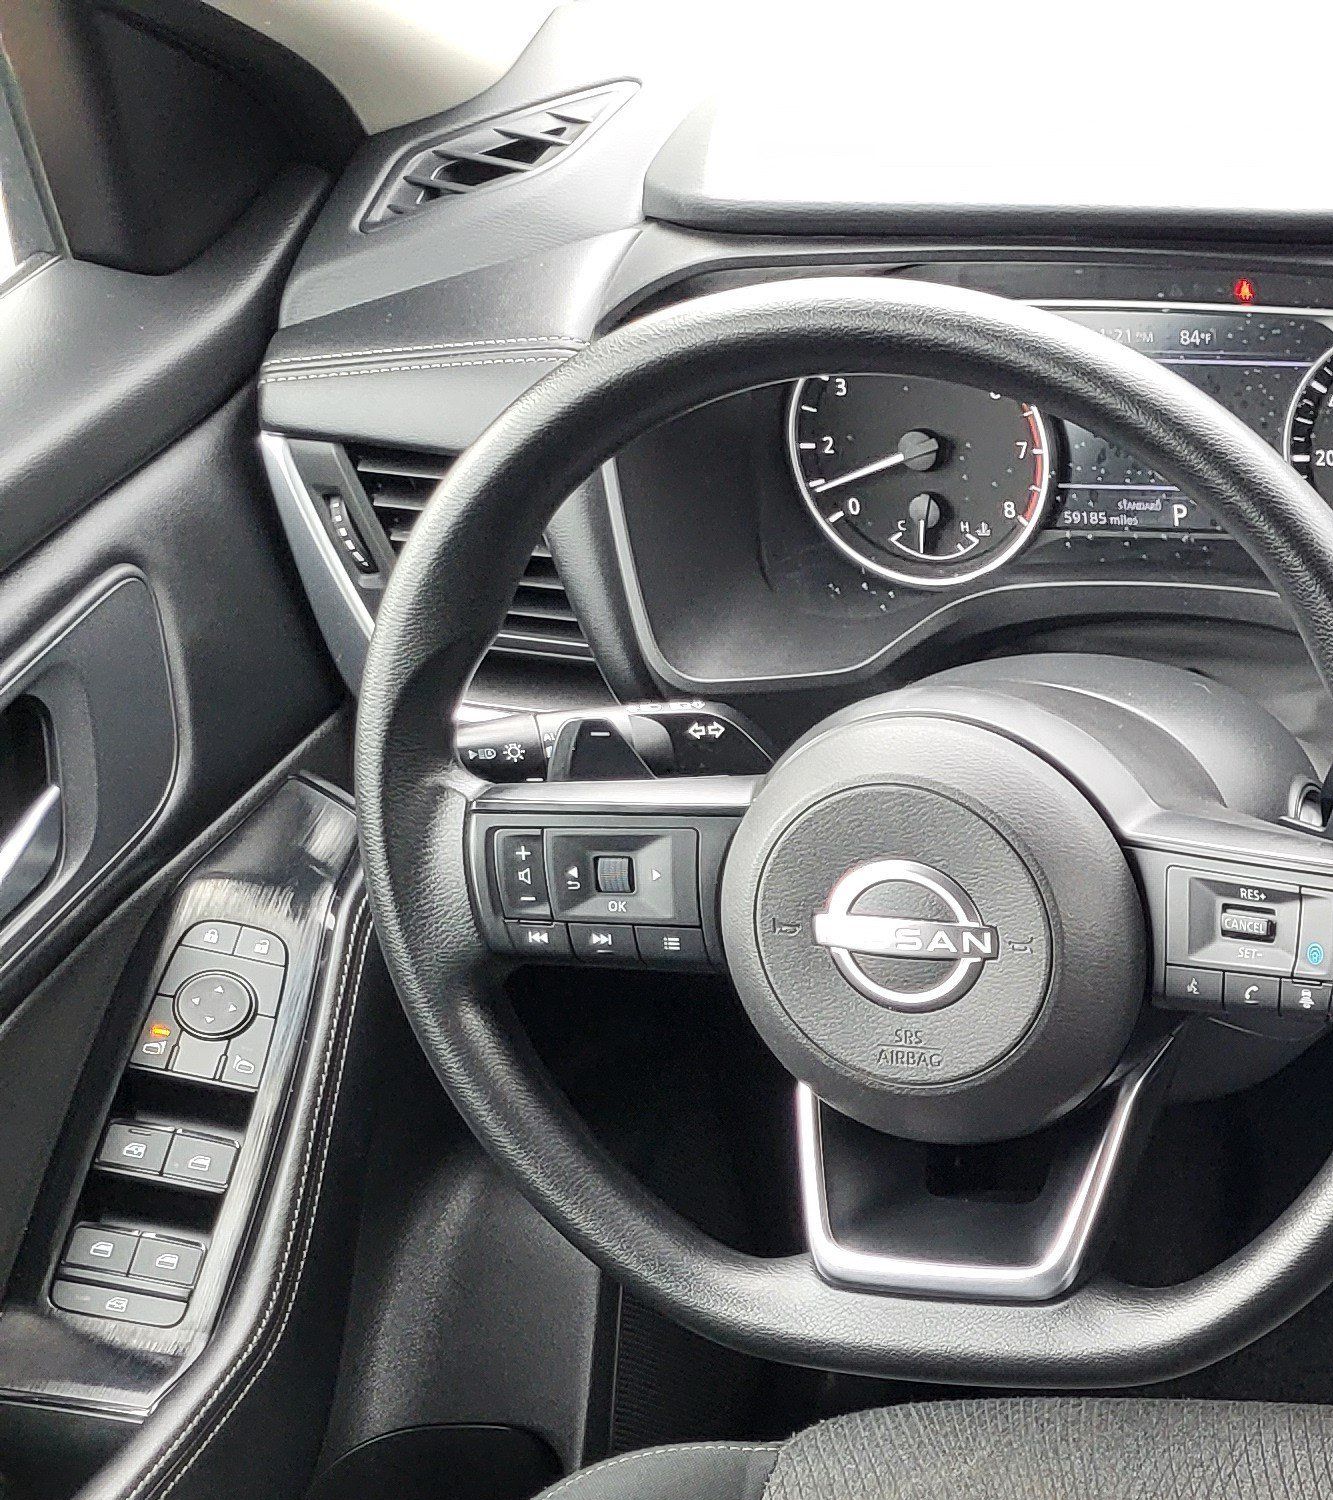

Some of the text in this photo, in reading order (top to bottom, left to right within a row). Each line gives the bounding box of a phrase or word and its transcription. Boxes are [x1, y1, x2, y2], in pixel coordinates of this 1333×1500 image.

[835, 377, 848, 397] 3
[821, 435, 835, 454] 2
[1014, 440, 1029, 459] 7
[847, 496, 861, 516] 0
[1003, 500, 1016, 519] 8
[1172, 503, 1188, 527] P
[896, 519, 906, 532] C
[959, 519, 970, 533] H
[1064, 509, 1139, 526] 59185 miles
[607, 901, 627, 914] OK
[1224, 918, 1266, 935] CANCEL
[893, 1028, 924, 1045] SRS
[877, 1048, 943, 1068] AIRBAG
